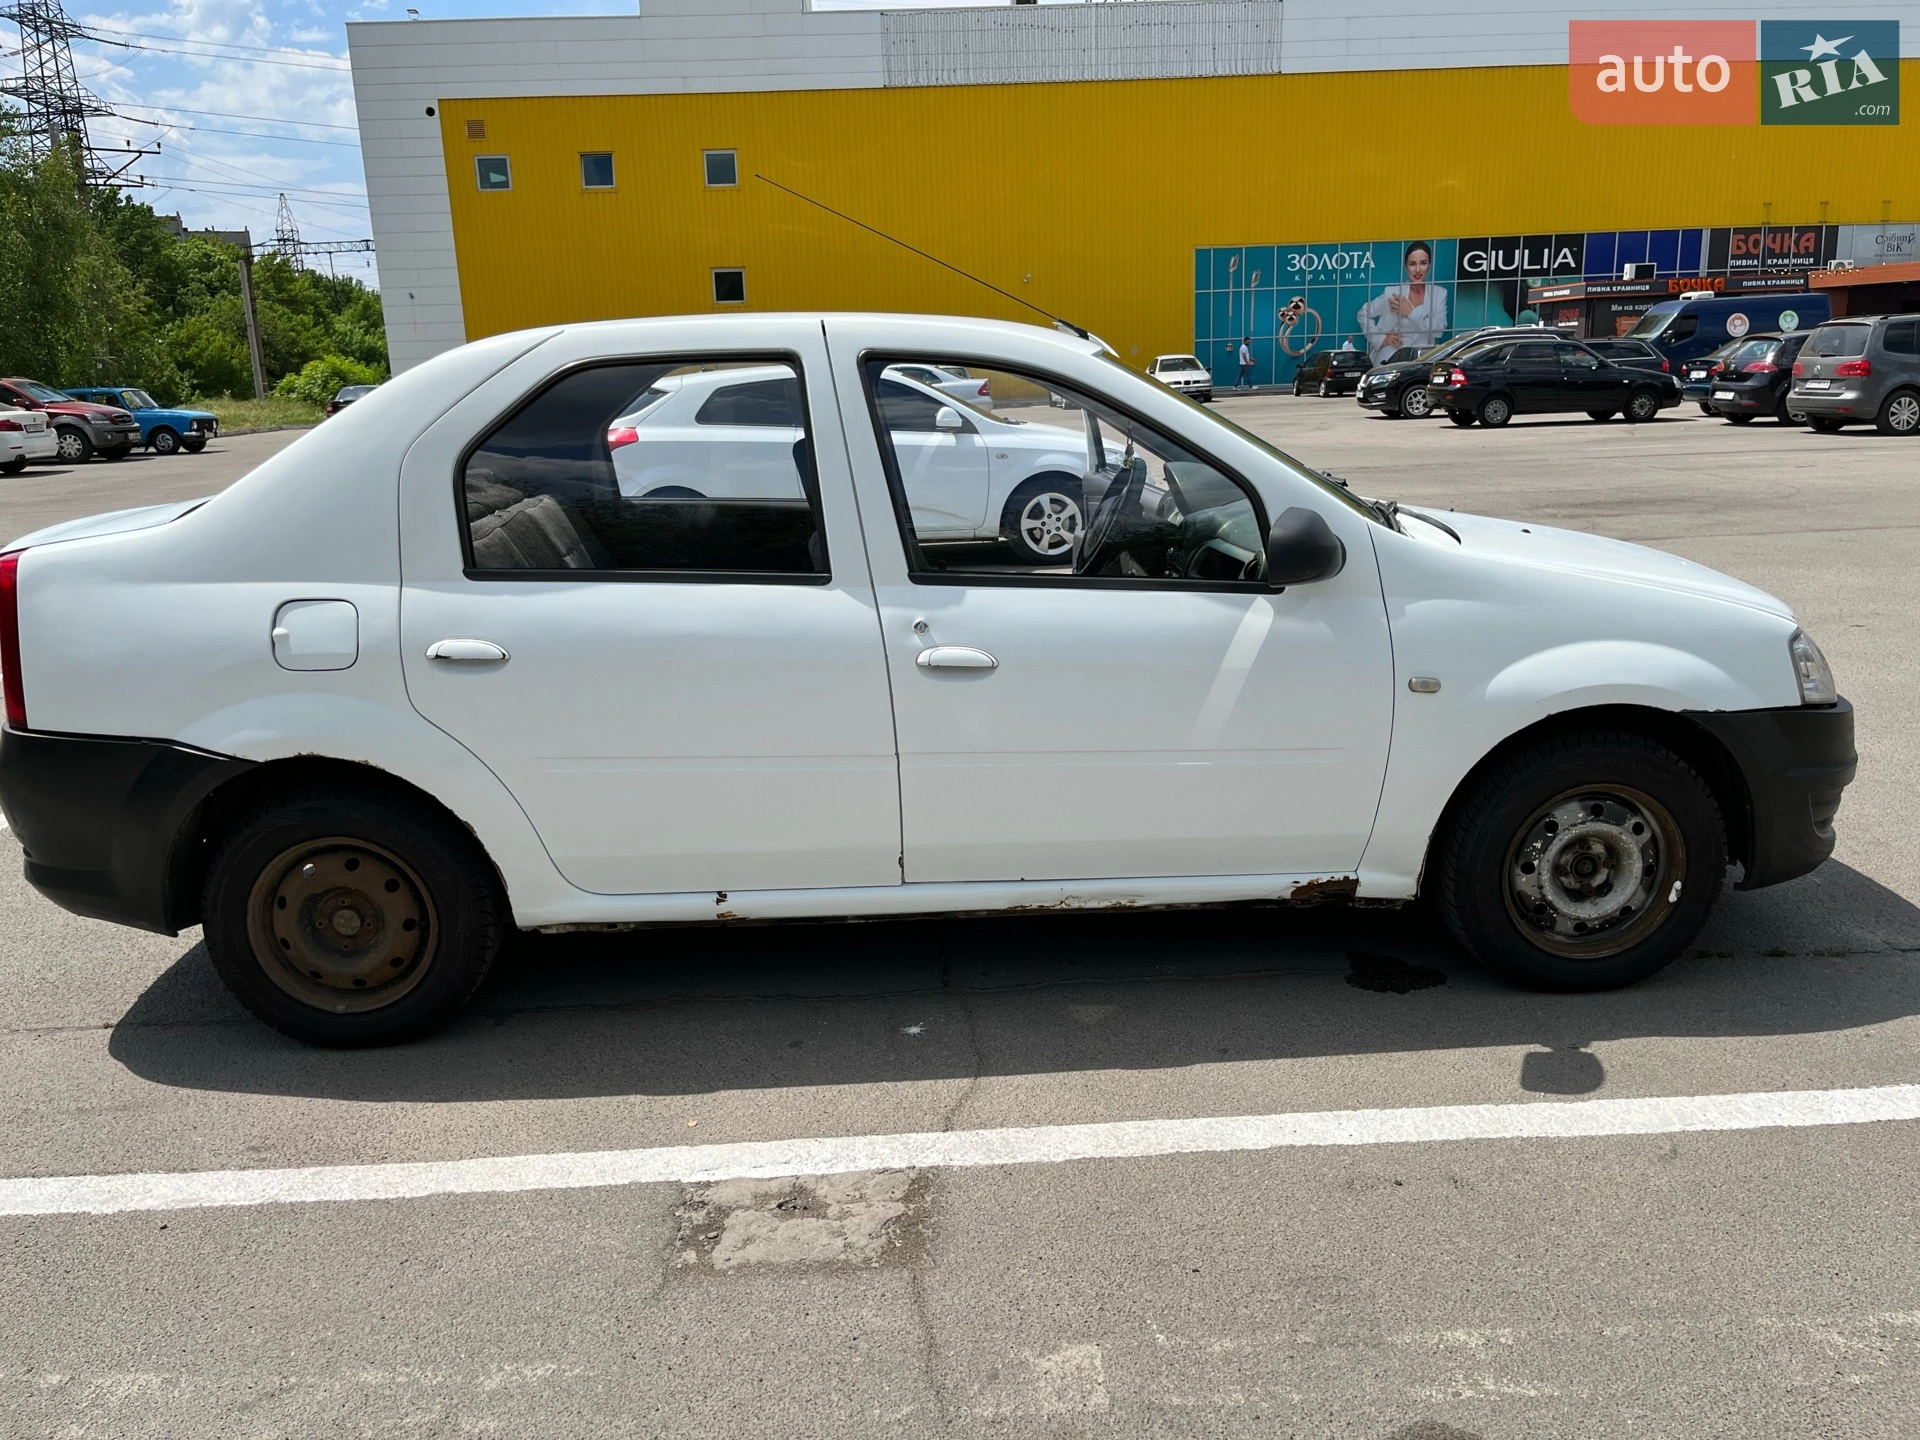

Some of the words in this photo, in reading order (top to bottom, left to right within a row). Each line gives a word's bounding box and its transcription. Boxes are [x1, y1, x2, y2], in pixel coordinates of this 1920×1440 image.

[1731, 232, 1815, 255] БОЧКА
[1286, 251, 1375, 271] ЗОЛОТА
[1463, 247, 1576, 272] GIULIA
[1767, 257, 1814, 265] КРАМНИЦЯ
[1612, 284, 1650, 292] КРАМНИЦЯ
[1667, 277, 1725, 293] БОЧКА
